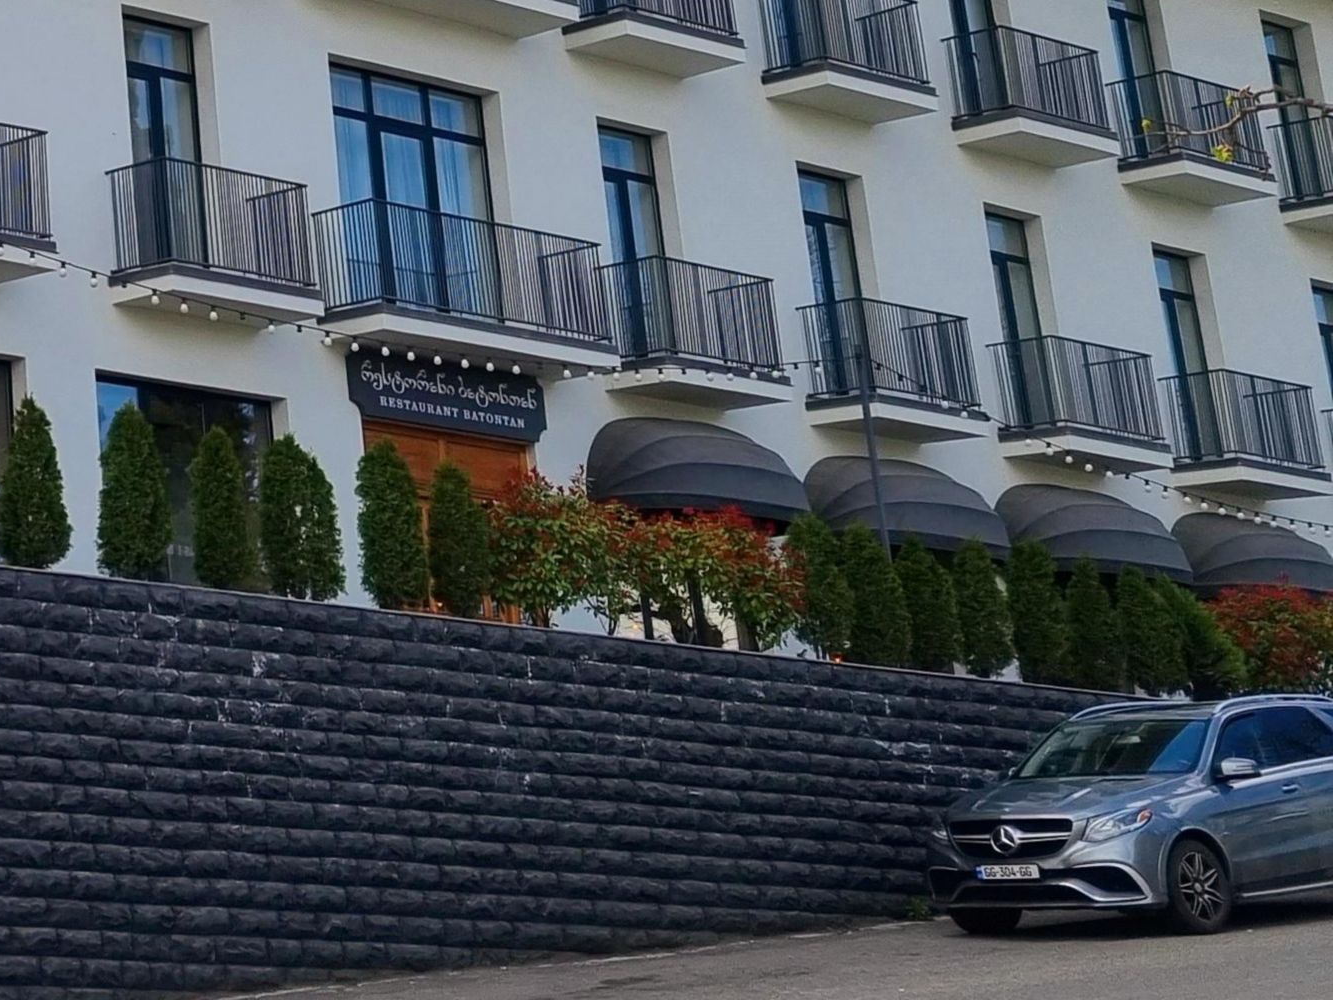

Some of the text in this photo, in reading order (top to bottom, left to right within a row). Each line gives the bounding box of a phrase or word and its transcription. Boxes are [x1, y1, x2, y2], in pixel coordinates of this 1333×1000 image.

[360, 359, 538, 410] რესტორანი ბატონთან
[379, 395, 525, 429] RESTAURANT BATONTAN
